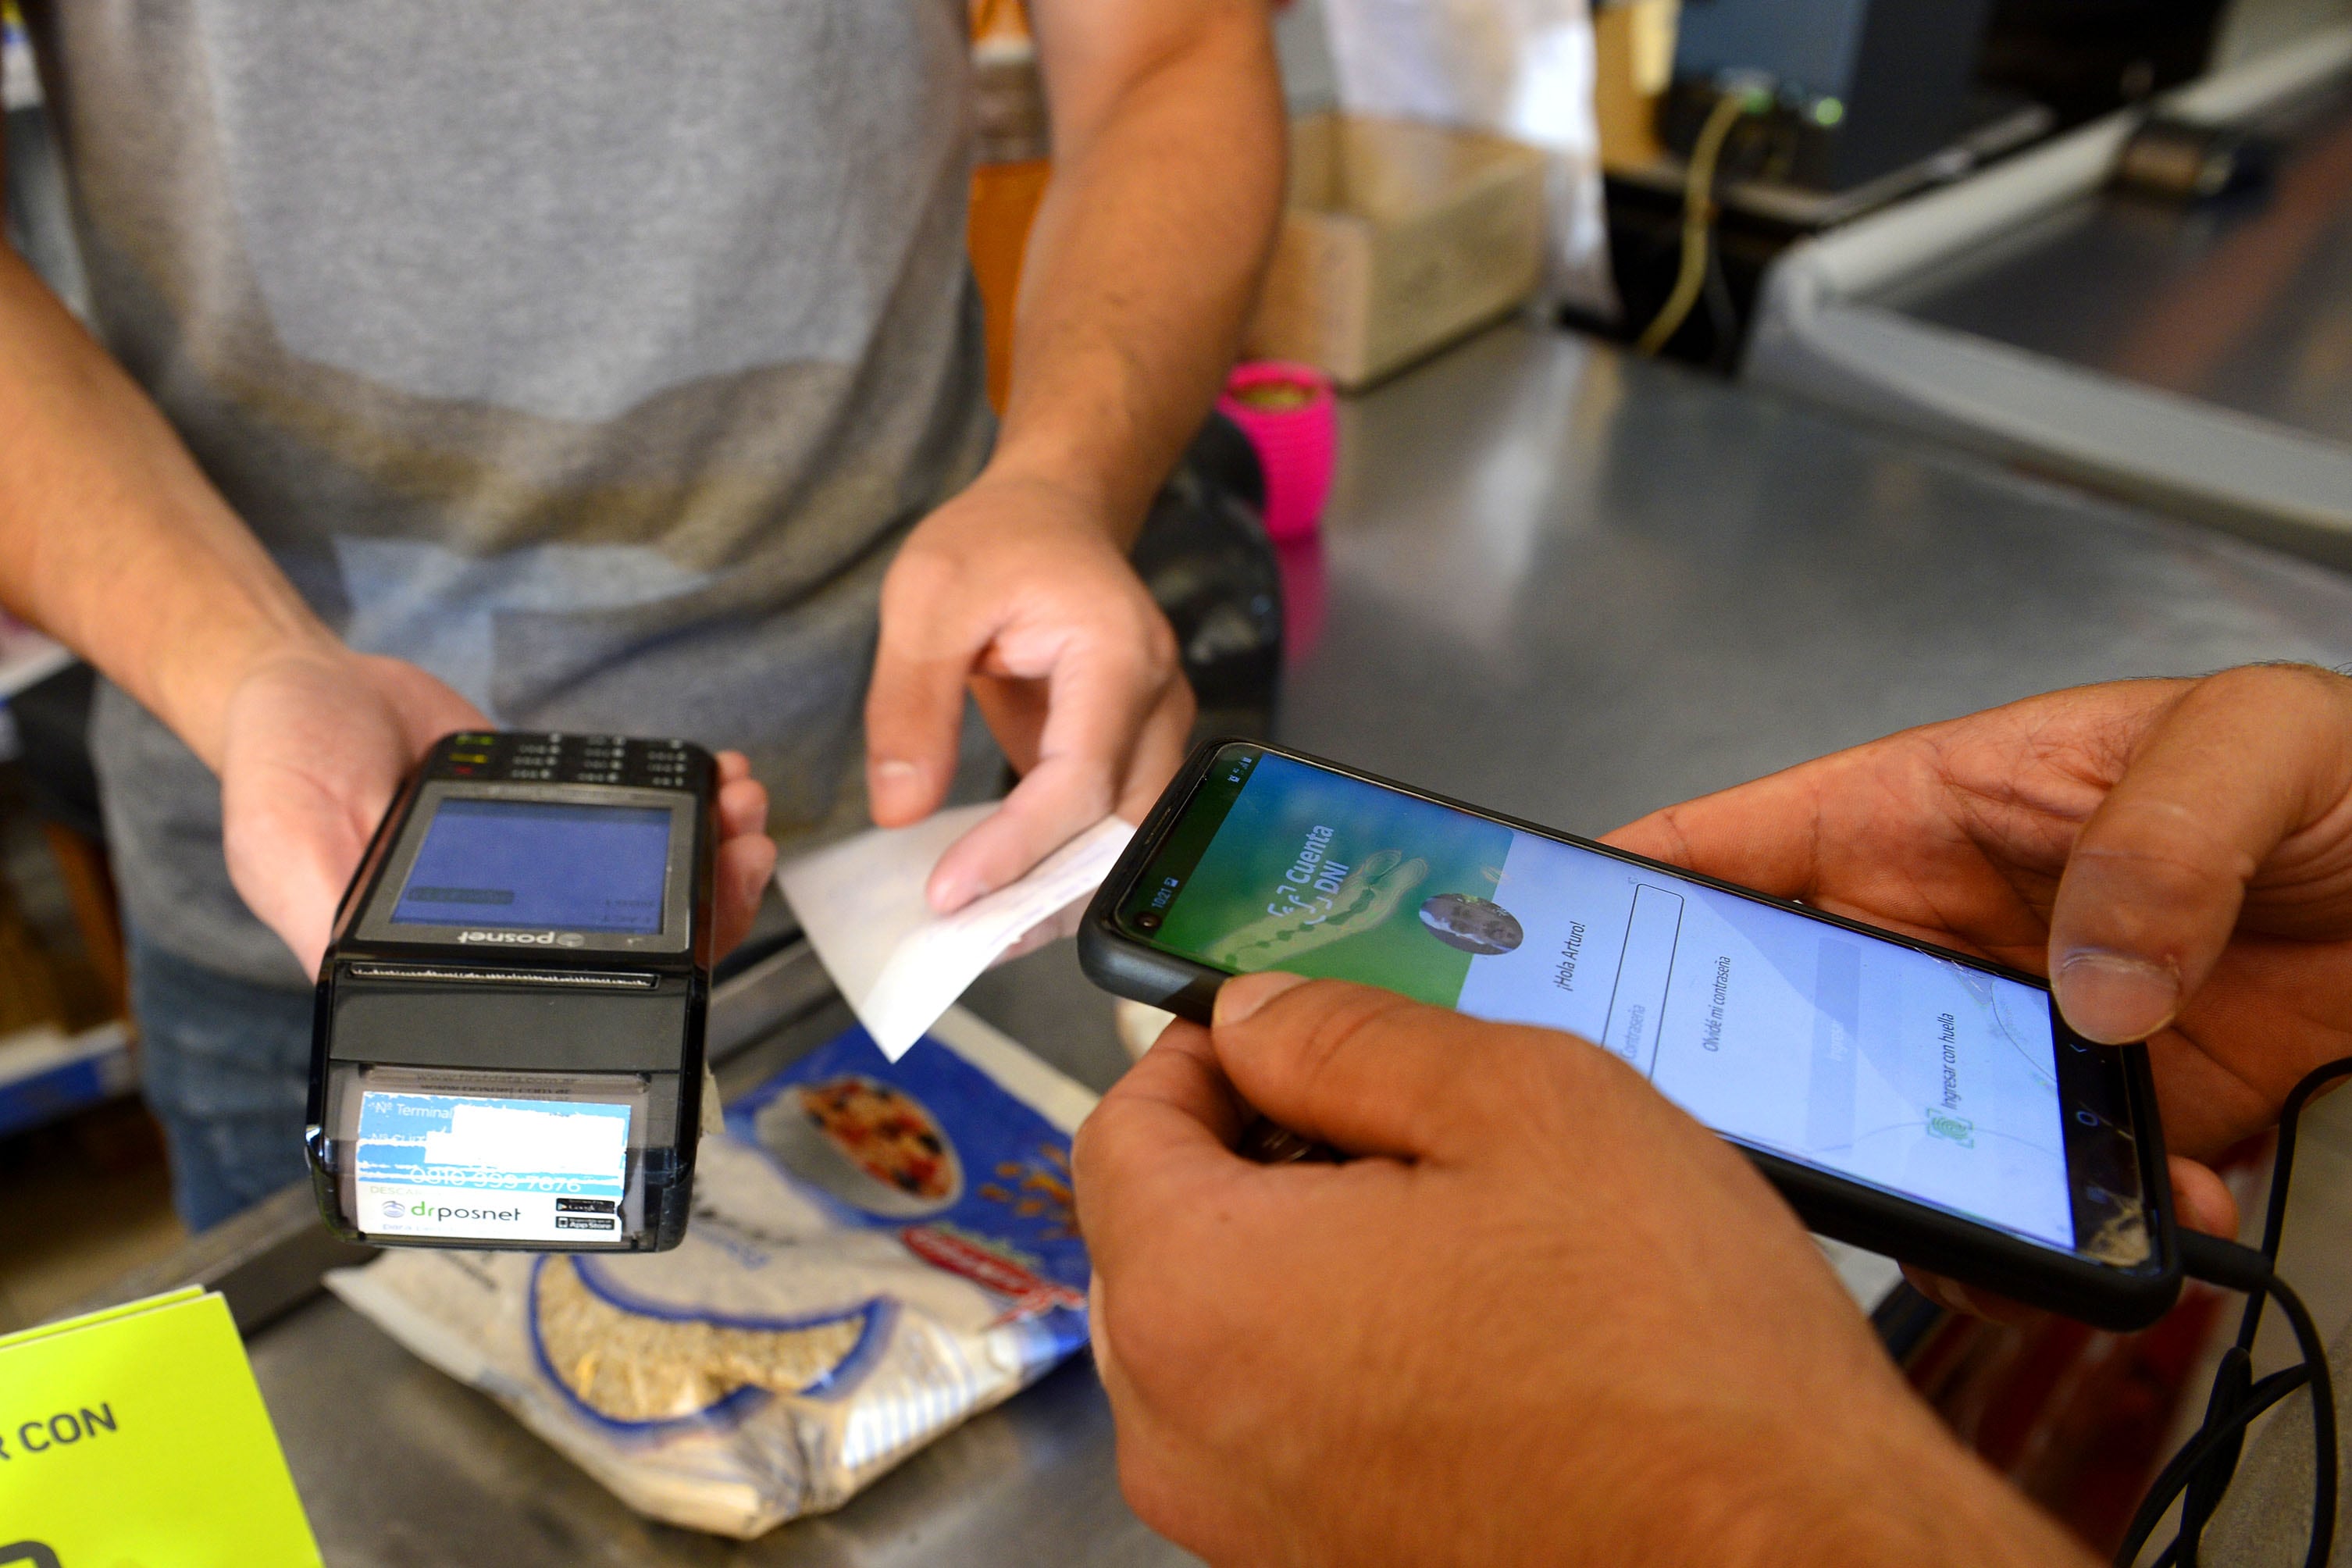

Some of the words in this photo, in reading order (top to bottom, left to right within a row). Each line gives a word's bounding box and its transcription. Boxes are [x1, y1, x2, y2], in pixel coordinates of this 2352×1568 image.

[1285, 825, 1335, 884] Cuenta
[1313, 860, 1349, 894] DNI
[458, 930, 555, 945] posnet
[1561, 921, 1586, 961] Arturo!
[1553, 961, 1575, 992] ¡Hola
[1712, 956, 1731, 1006] contraseña
[1708, 1004, 1724, 1019] mi
[1937, 1012, 1955, 1044] huella
[1702, 1018, 1723, 1053] Olvidé
[1943, 1044, 1955, 1064] con
[1941, 1064, 1962, 1110] Ingresar
[397, 1103, 454, 1119] Terminal
[411, 1200, 522, 1222] drposnet
[18, 1402, 117, 1452] CON
